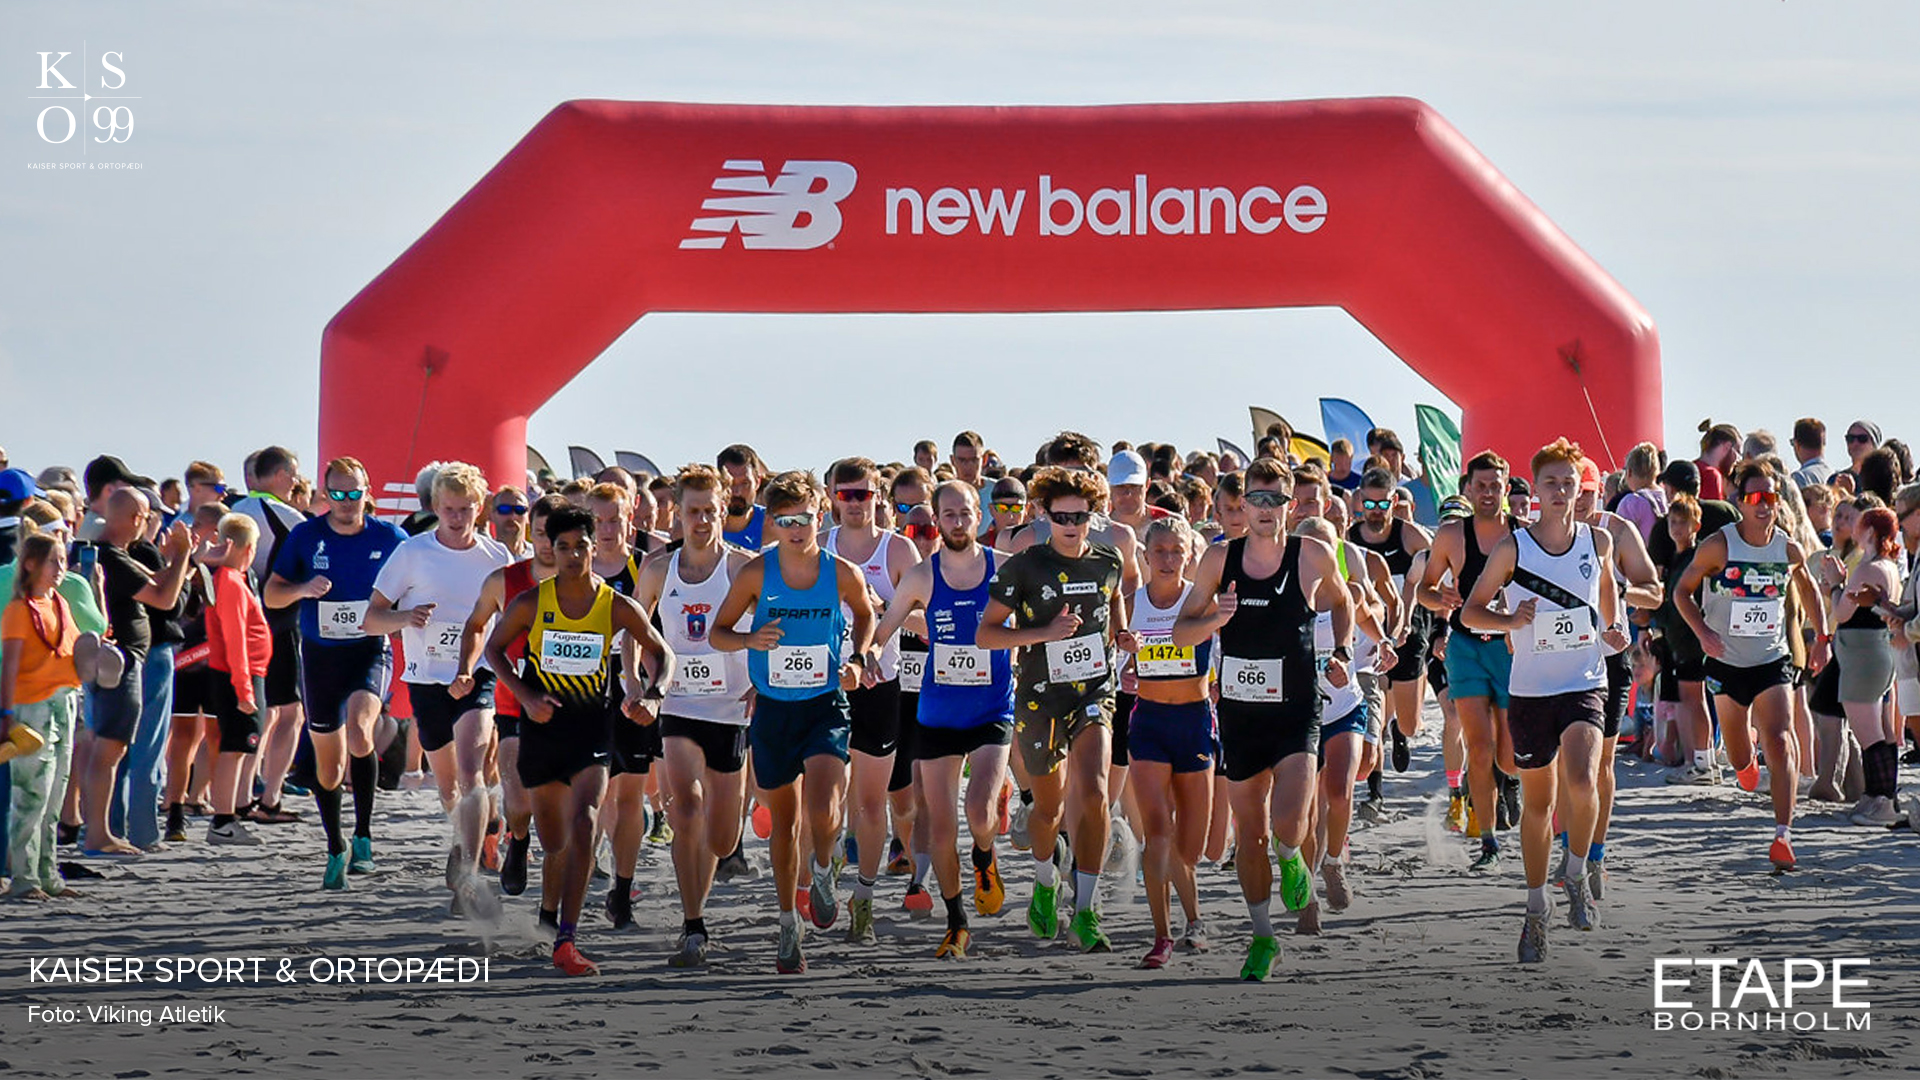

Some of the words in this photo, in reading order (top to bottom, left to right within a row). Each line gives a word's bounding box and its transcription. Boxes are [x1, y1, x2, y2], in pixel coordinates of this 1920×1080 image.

[885, 188, 1026, 236] new
[1039, 173, 1328, 236] balance
[332, 612, 357, 624] 498
[768, 607, 832, 620] SPARTA
[1744, 611, 1768, 623] 570
[1555, 621, 1574, 635] 20
[440, 632, 462, 646] 27
[552, 643, 592, 659] 3032
[1063, 647, 1092, 665] 699
[1147, 646, 1184, 660] 1474
[784, 657, 814, 671] 266
[948, 656, 976, 669] 470
[683, 665, 711, 679] 169
[1237, 671, 1267, 685] 666
